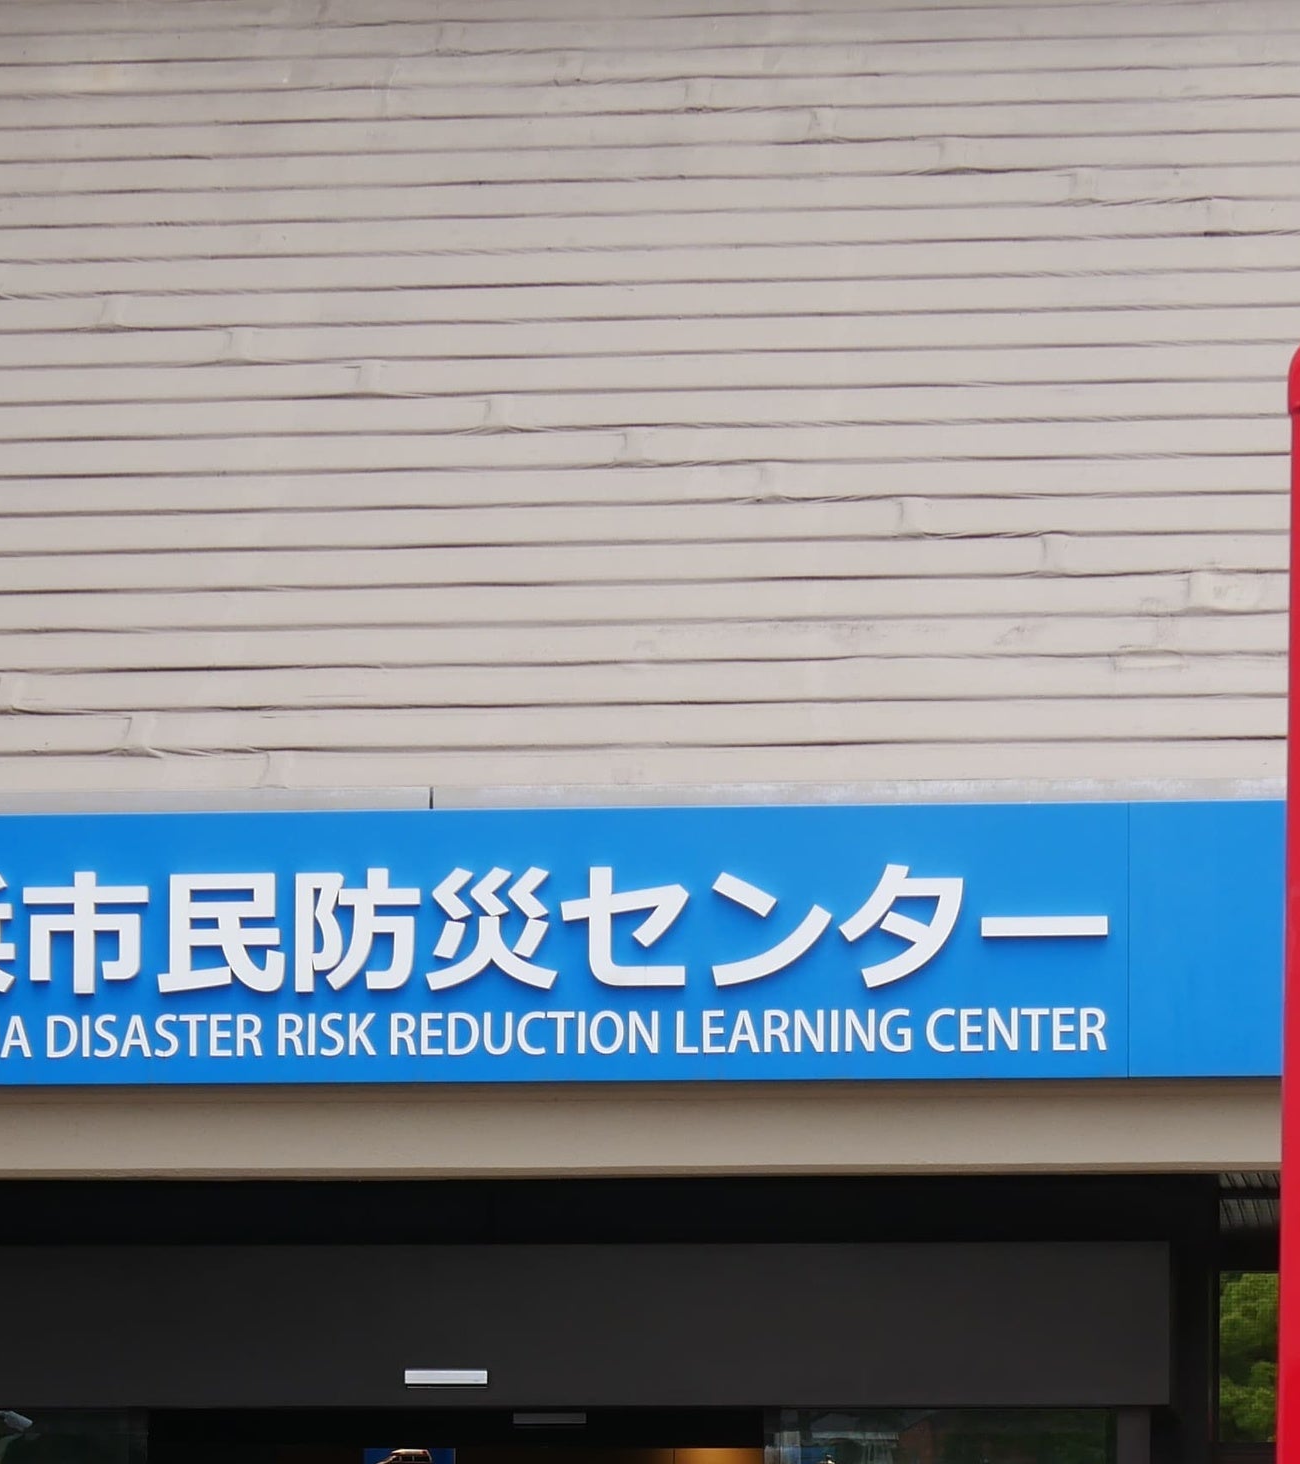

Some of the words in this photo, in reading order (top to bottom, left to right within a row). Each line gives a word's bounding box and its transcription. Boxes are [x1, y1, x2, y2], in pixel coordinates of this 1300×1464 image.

[46, 1012, 262, 1058] DISASTER
[277, 1011, 376, 1057] RISK
[389, 1009, 660, 1057] REDUCTION
[675, 1007, 913, 1055] LEARNING
[925, 1006, 1108, 1053] CENTER
